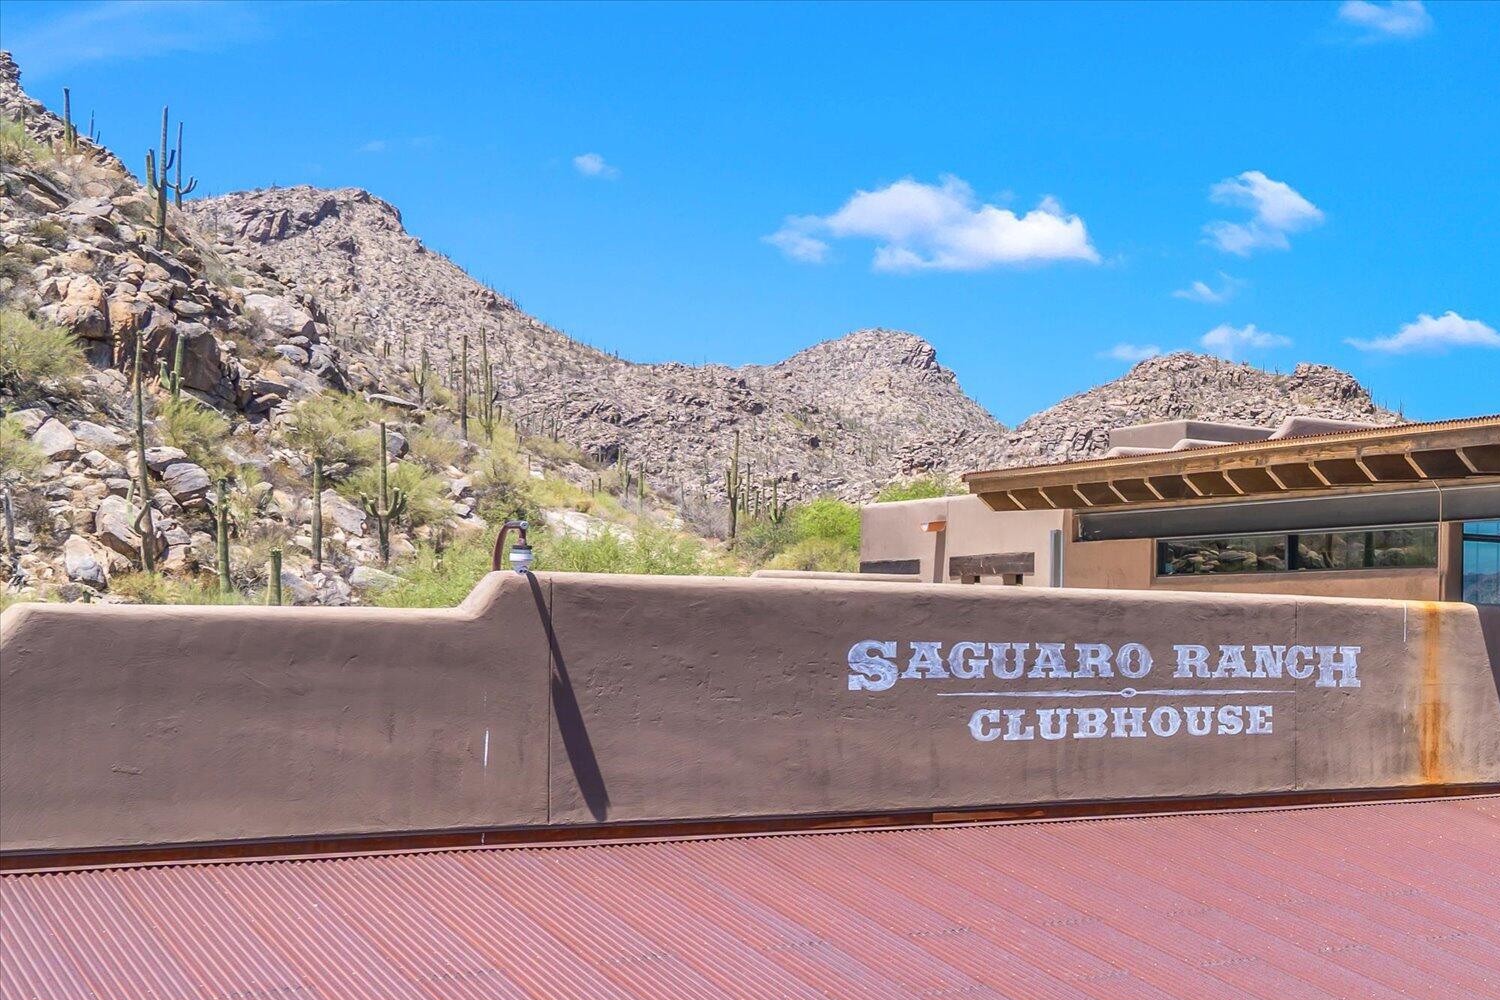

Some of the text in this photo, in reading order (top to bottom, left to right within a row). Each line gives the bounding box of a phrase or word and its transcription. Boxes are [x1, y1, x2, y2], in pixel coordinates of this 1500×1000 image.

[847, 639, 1362, 692] SAGUARO RANCH
[967, 705, 1274, 742] CLUBHOUSE
